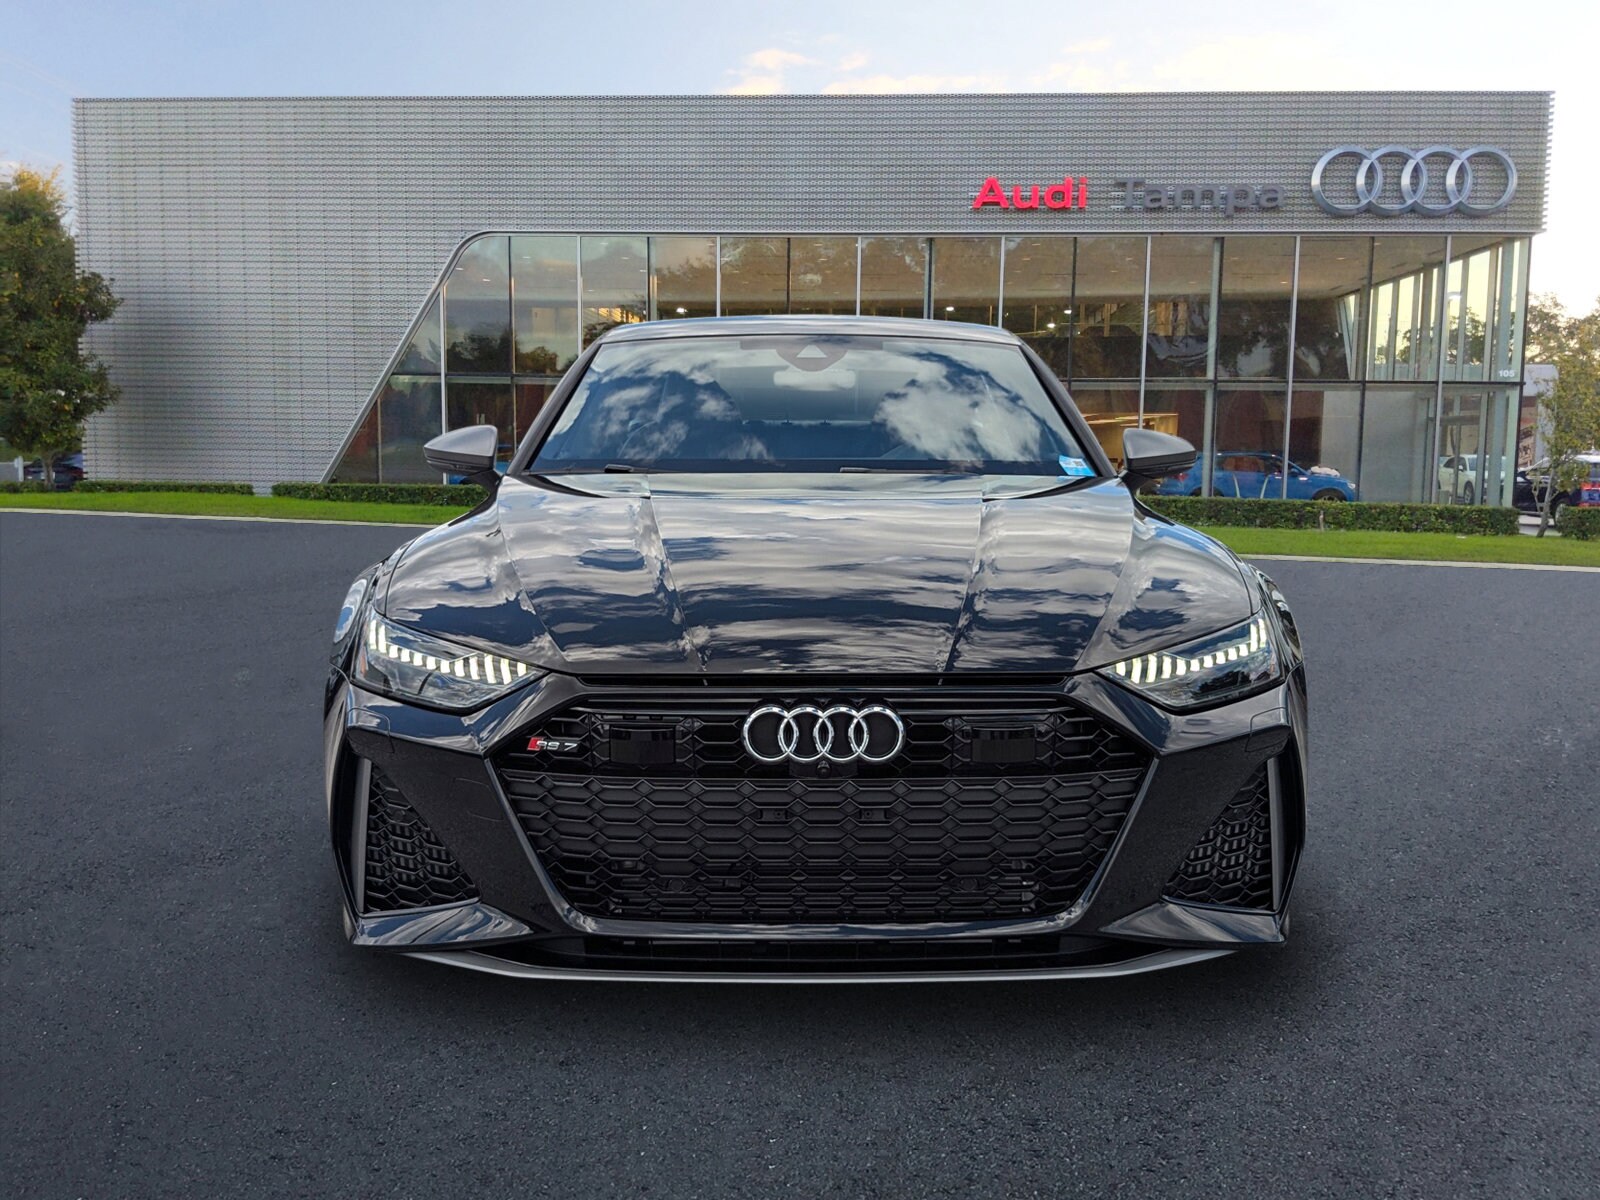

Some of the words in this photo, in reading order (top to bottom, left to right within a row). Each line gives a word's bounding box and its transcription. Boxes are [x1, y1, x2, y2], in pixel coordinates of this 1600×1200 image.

[973, 177, 1088, 209] Audi
[1115, 177, 1284, 217] Tampa
[1498, 369, 1515, 378] 105
